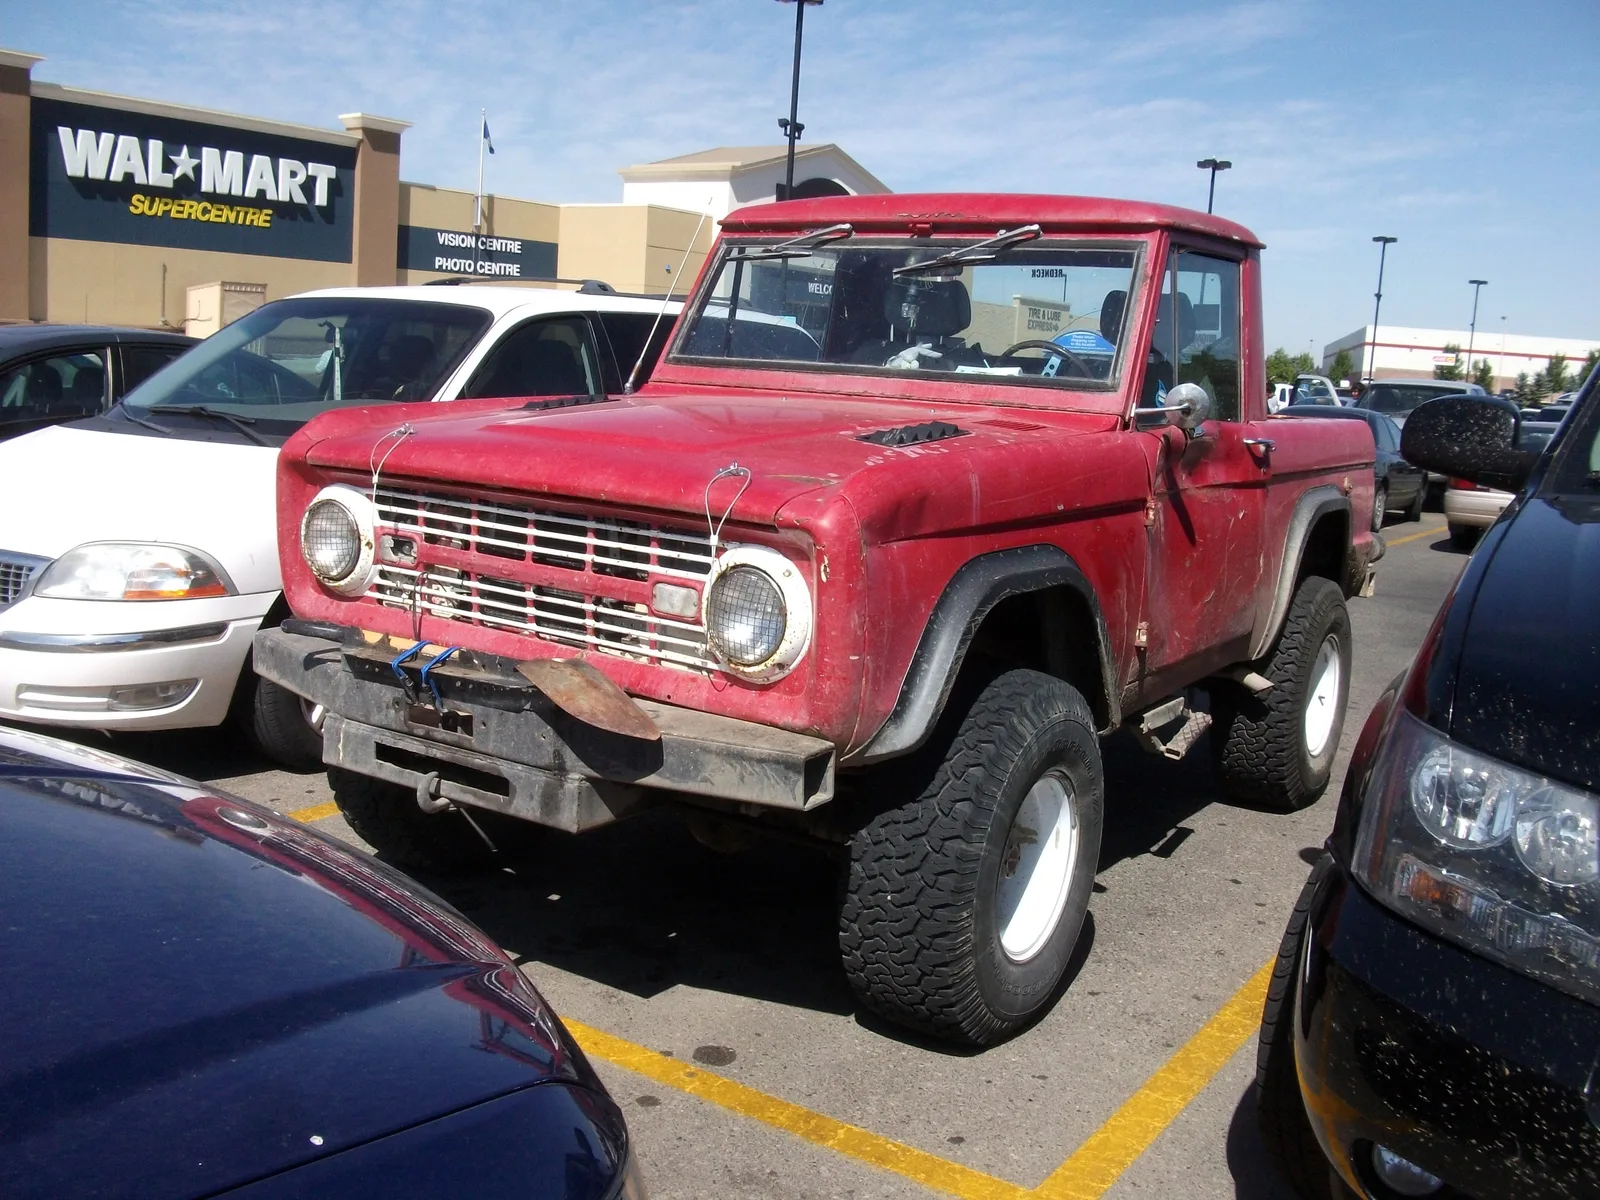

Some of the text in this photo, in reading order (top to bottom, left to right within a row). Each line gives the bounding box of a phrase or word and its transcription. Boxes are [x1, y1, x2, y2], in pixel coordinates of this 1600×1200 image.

[129, 194, 273, 228] SUPERCENTRE
[437, 232, 522, 254] VISION CENTRE
[435, 256, 521, 276] PHOTO CENTRE
[1028, 307, 1041, 319] TIRE
[1047, 311, 1061, 321] LUBE
[1027, 319, 1053, 332] EXPRESS
